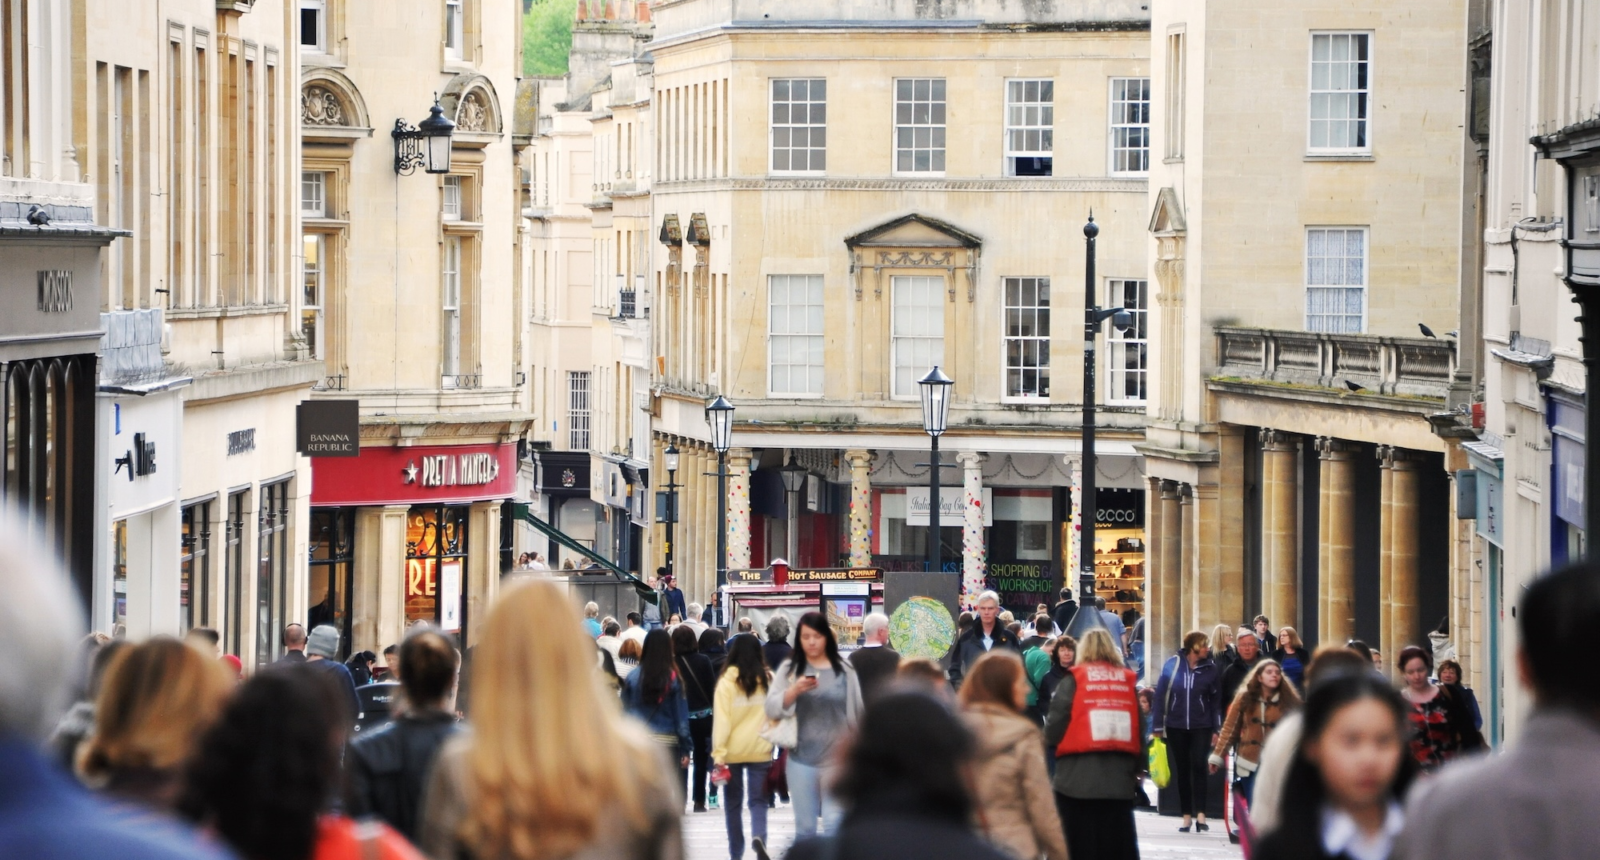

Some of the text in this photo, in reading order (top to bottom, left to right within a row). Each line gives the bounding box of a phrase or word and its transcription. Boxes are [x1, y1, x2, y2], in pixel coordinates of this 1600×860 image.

[310, 434, 350, 442] BANANA
[307, 443, 353, 452] REPUBLIC
[422, 455, 446, 486] PRET
[460, 453, 492, 485] MANGER
[1096, 508, 1135, 523] ecco
[740, 569, 877, 580] THE HOT SAUSAGE COMPANY
[990, 563, 1040, 578] SHOPPING
[1087, 669, 1127, 682] ISSUE
